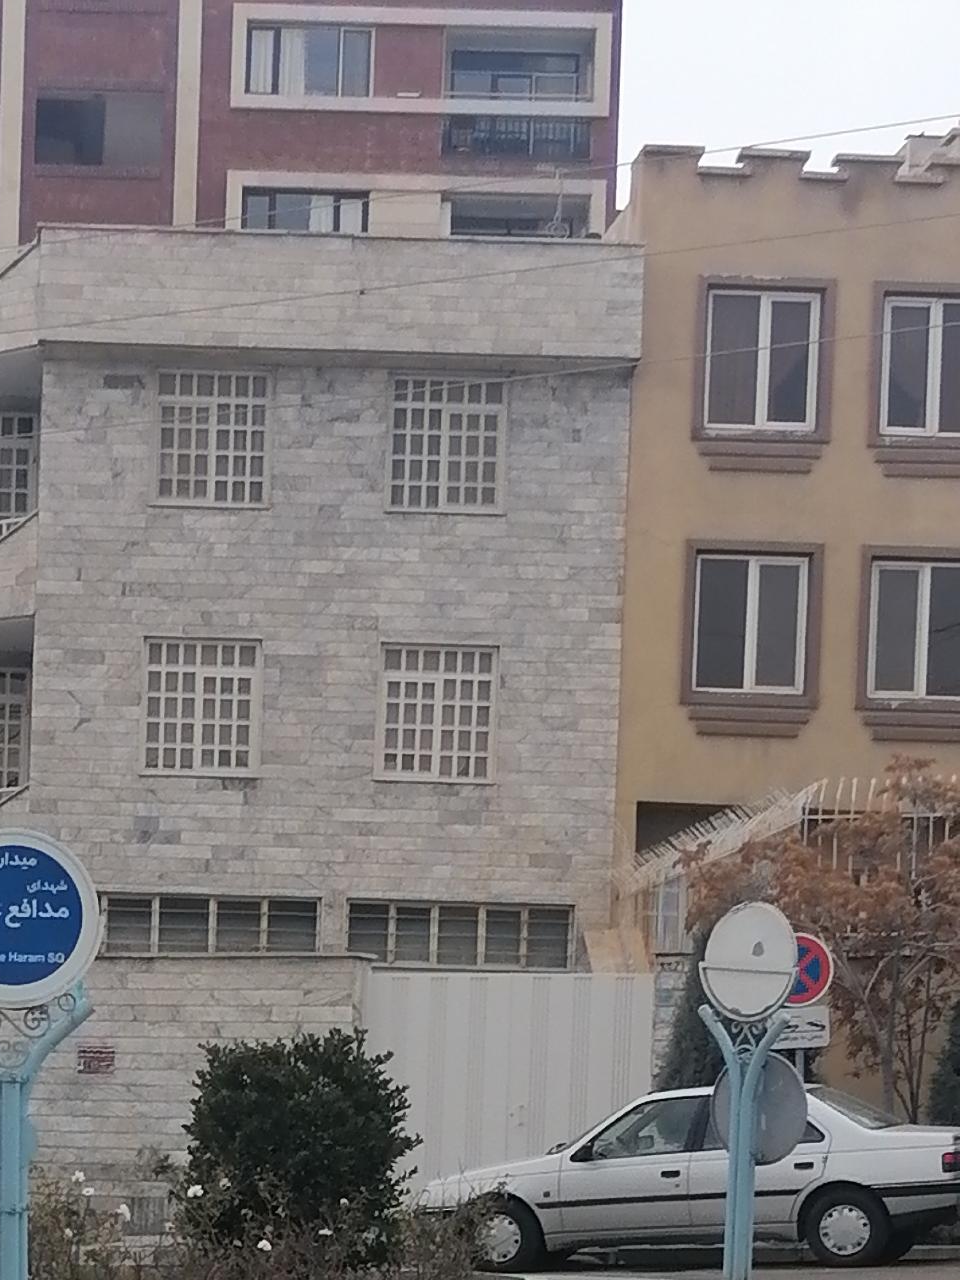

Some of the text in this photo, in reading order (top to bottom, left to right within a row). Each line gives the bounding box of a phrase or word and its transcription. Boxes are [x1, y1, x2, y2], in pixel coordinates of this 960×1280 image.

[26, 880, 68, 894] شهدای
[4, 898, 70, 928] مدافع
[8, 951, 45, 963] Haram
